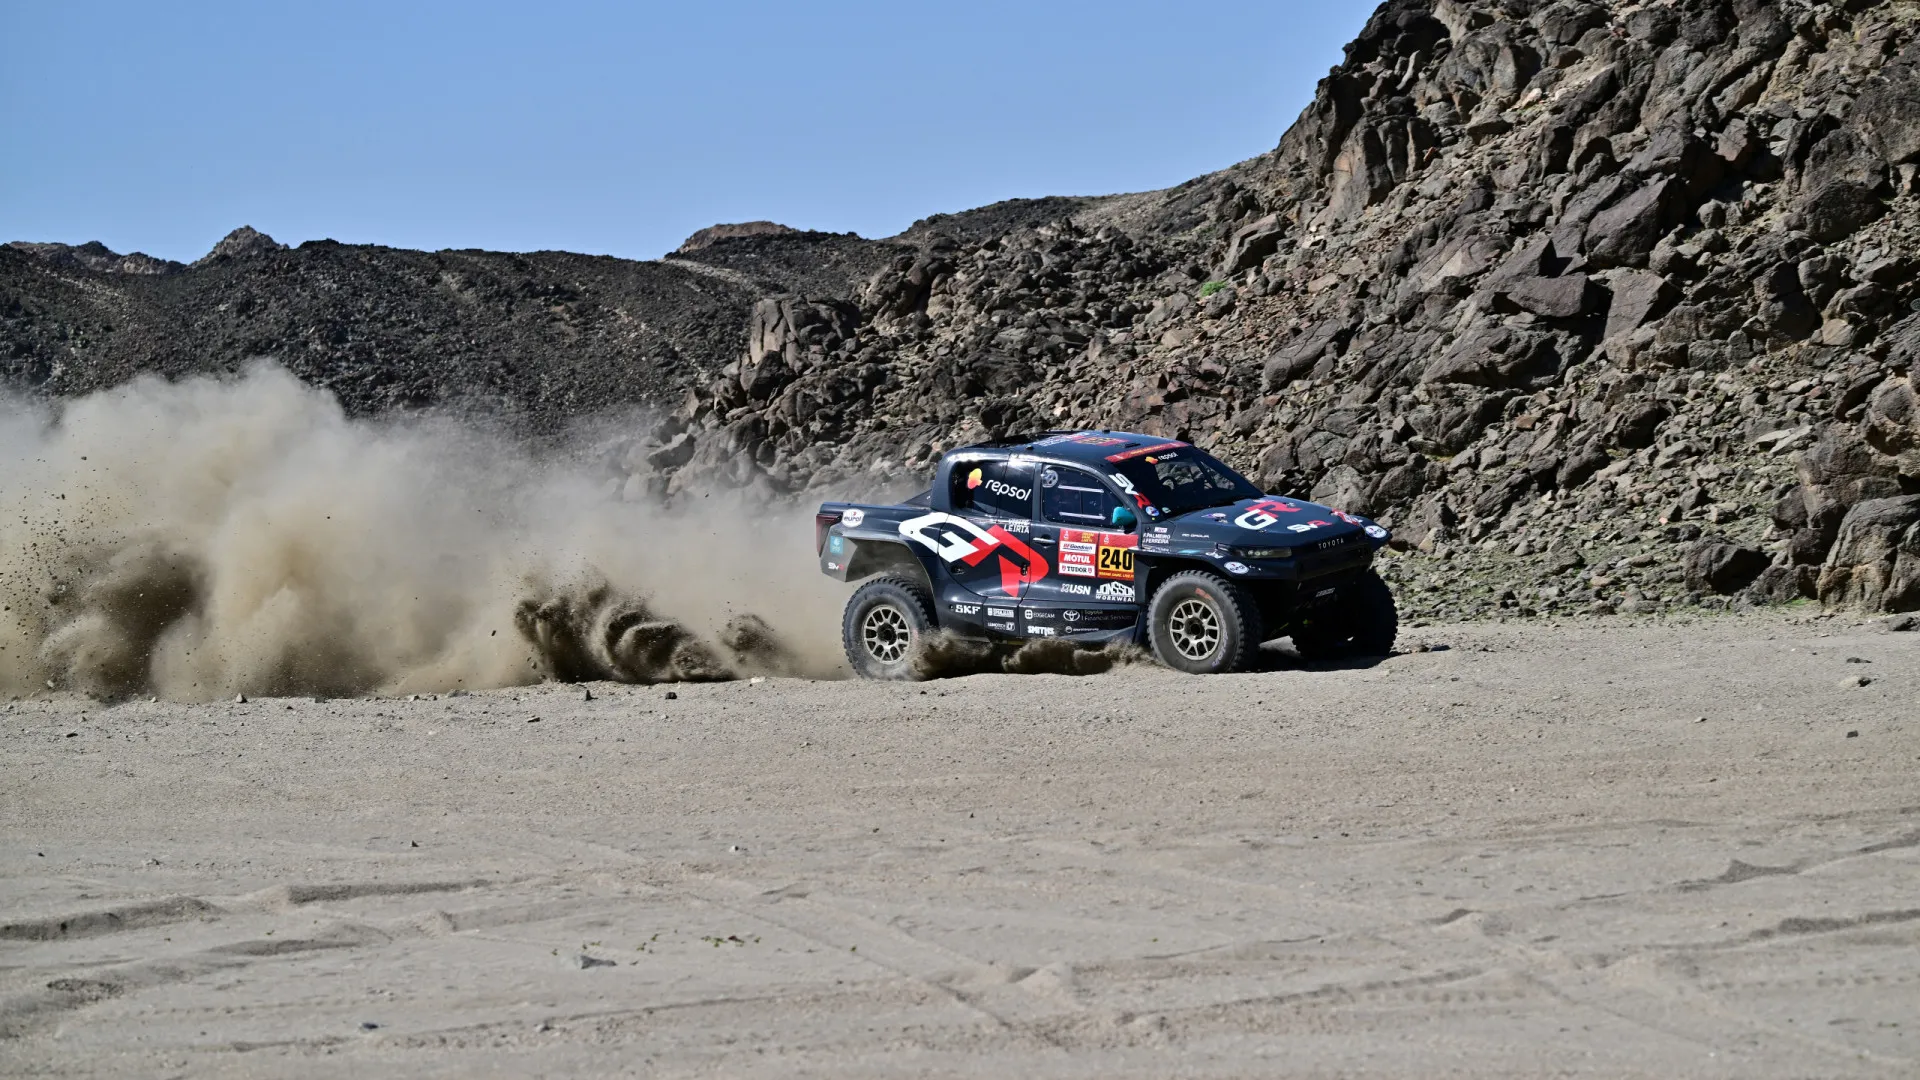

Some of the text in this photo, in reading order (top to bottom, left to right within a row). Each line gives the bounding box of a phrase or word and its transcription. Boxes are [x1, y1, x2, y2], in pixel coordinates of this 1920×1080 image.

[985, 479, 1031, 500] repsol
[1234, 500, 1302, 530] GR
[1003, 524, 1030, 534] LEIRIA
[1319, 538, 1344, 549] TOYOTA
[898, 512, 1049, 598] GR
[1063, 554, 1091, 563] MOTUL
[1101, 548, 1132, 570] 240
[1069, 584, 1091, 595] USN
[1095, 581, 1135, 595] JONSSON
[955, 604, 981, 615] SKF
